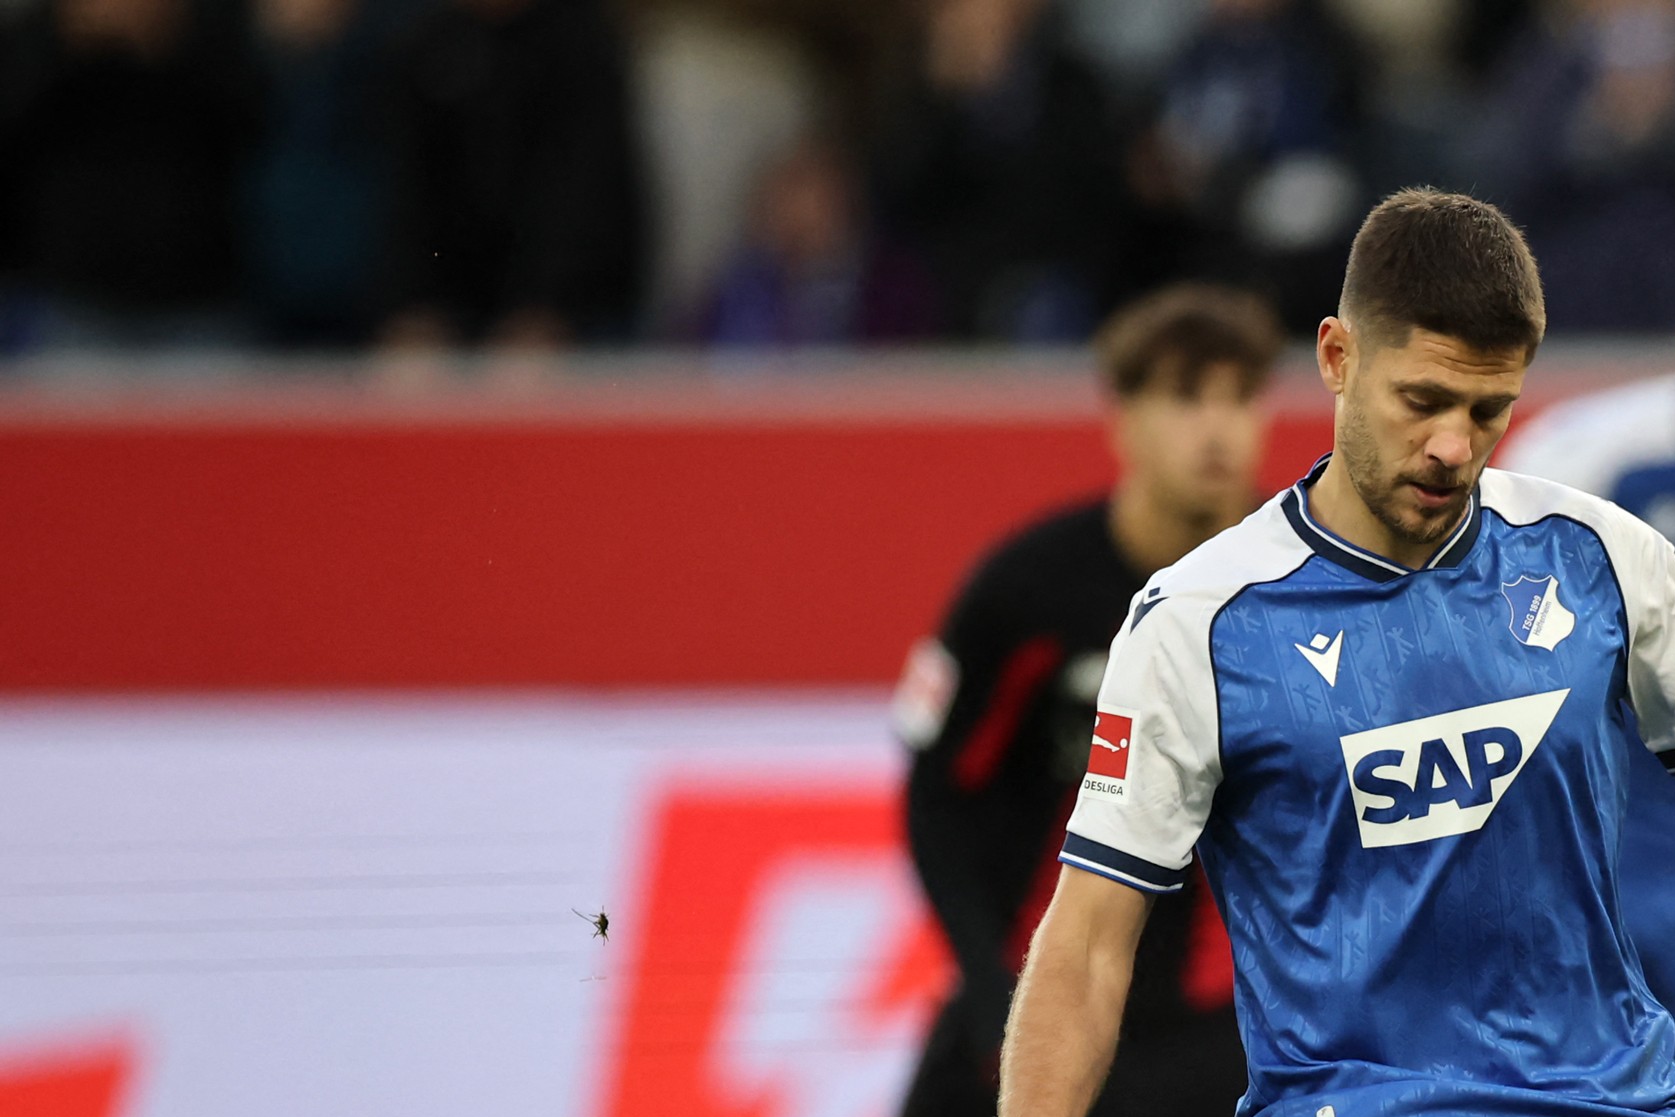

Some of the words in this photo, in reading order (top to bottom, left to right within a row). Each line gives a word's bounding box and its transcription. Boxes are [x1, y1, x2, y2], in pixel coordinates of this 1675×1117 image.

[1522, 613, 1535, 631] TSG
[1529, 595, 1542, 613] 1899
[1533, 601, 1552, 636] Hoffenheim
[1353, 727, 1523, 824] SAP
